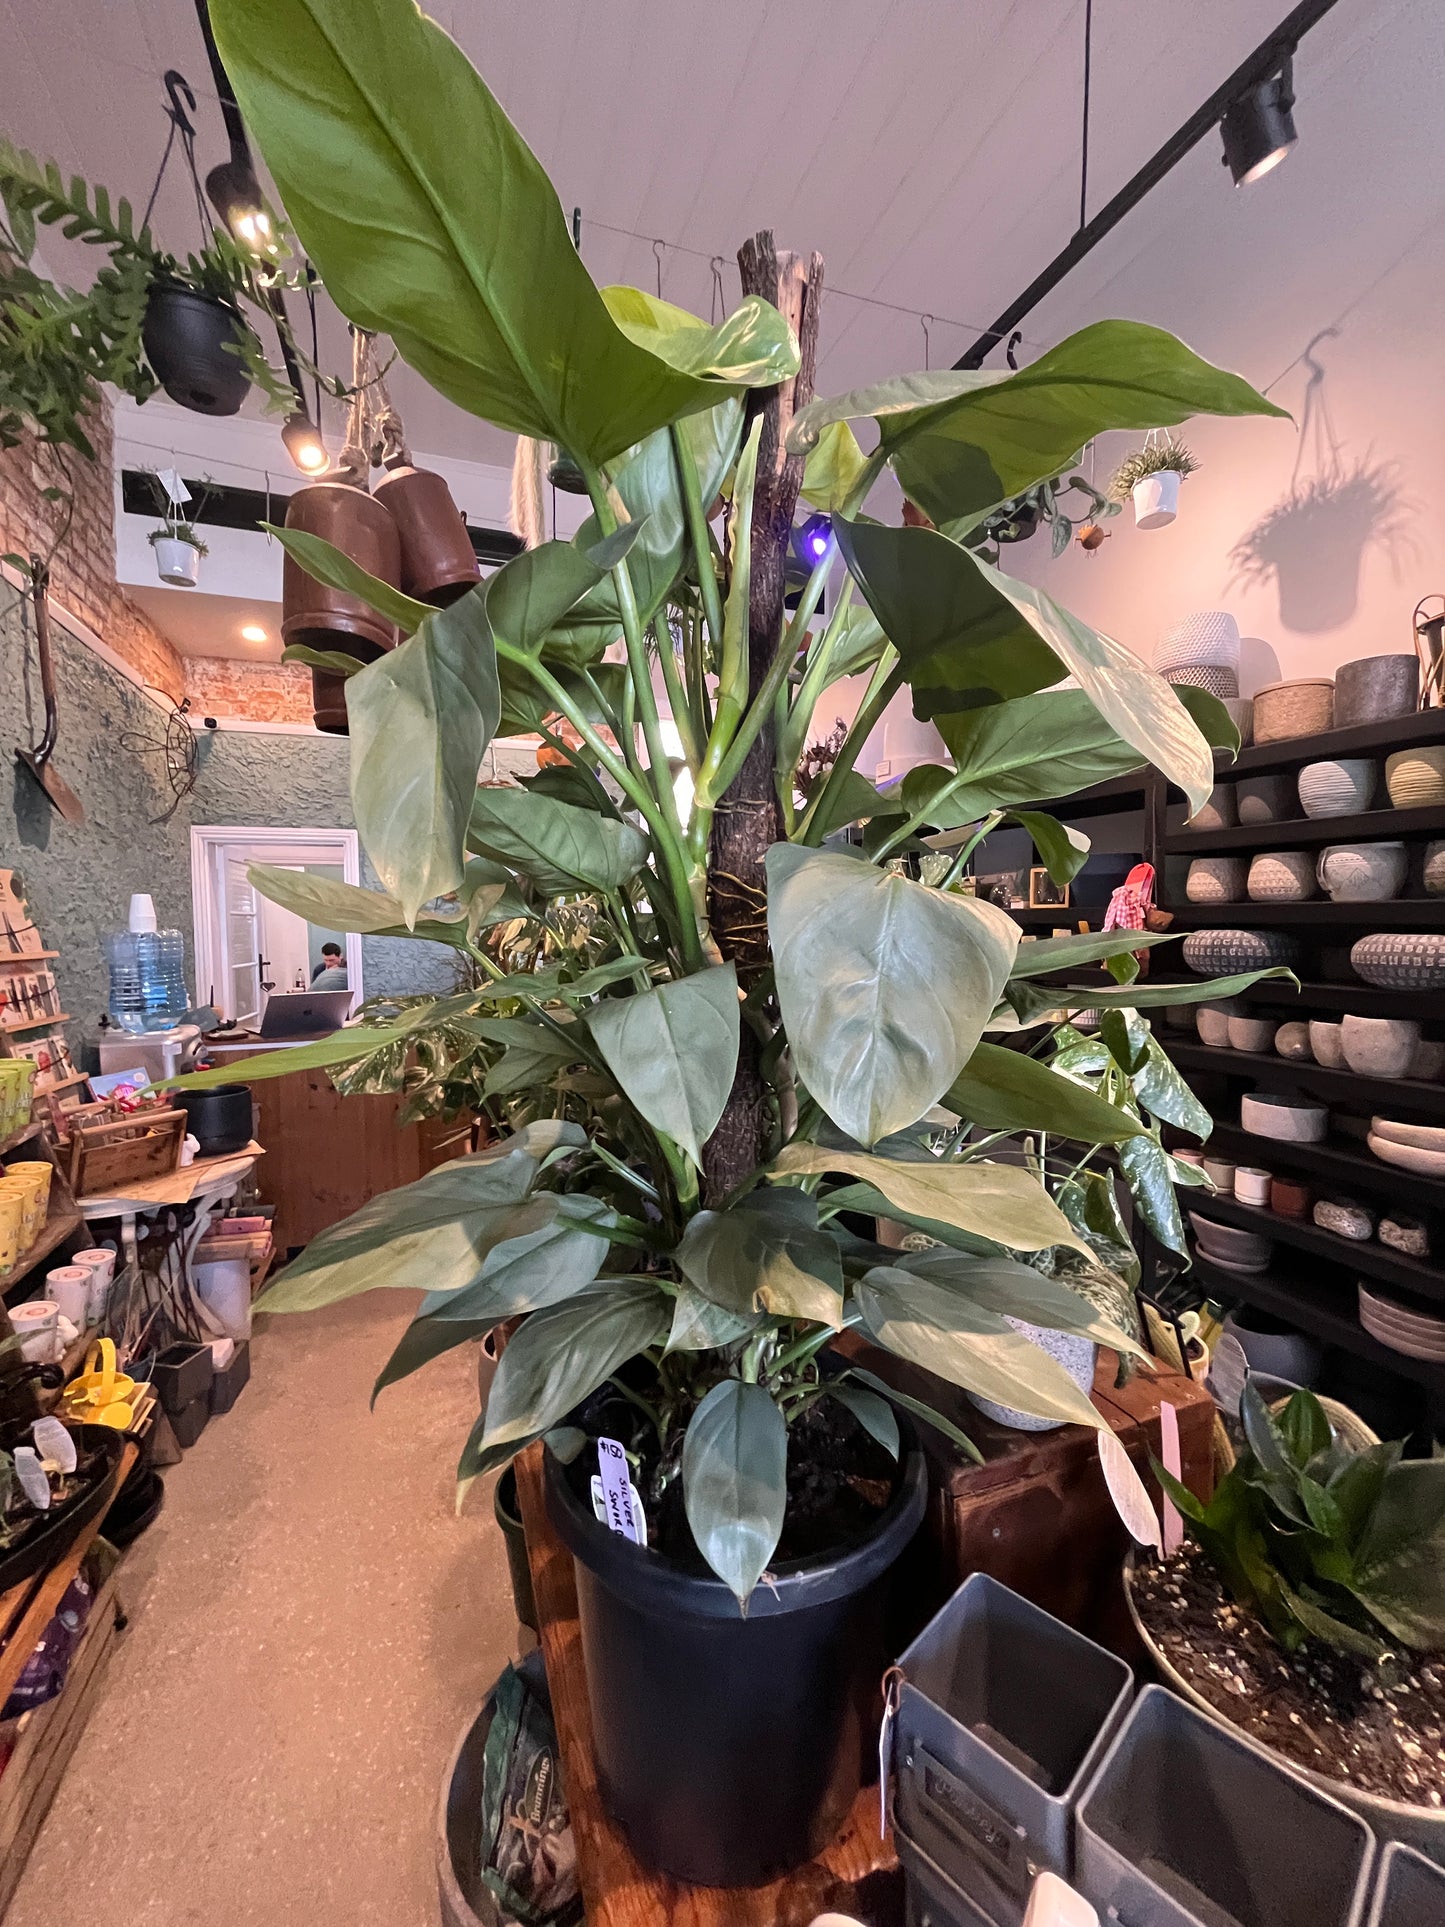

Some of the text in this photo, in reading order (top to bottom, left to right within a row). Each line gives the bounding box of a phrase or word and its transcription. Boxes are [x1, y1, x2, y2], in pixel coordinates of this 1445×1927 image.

[609, 1490, 624, 1537] SWORD
[619, 1478, 634, 1527] SILVER
[530, 1757, 550, 1823] Brunnings
